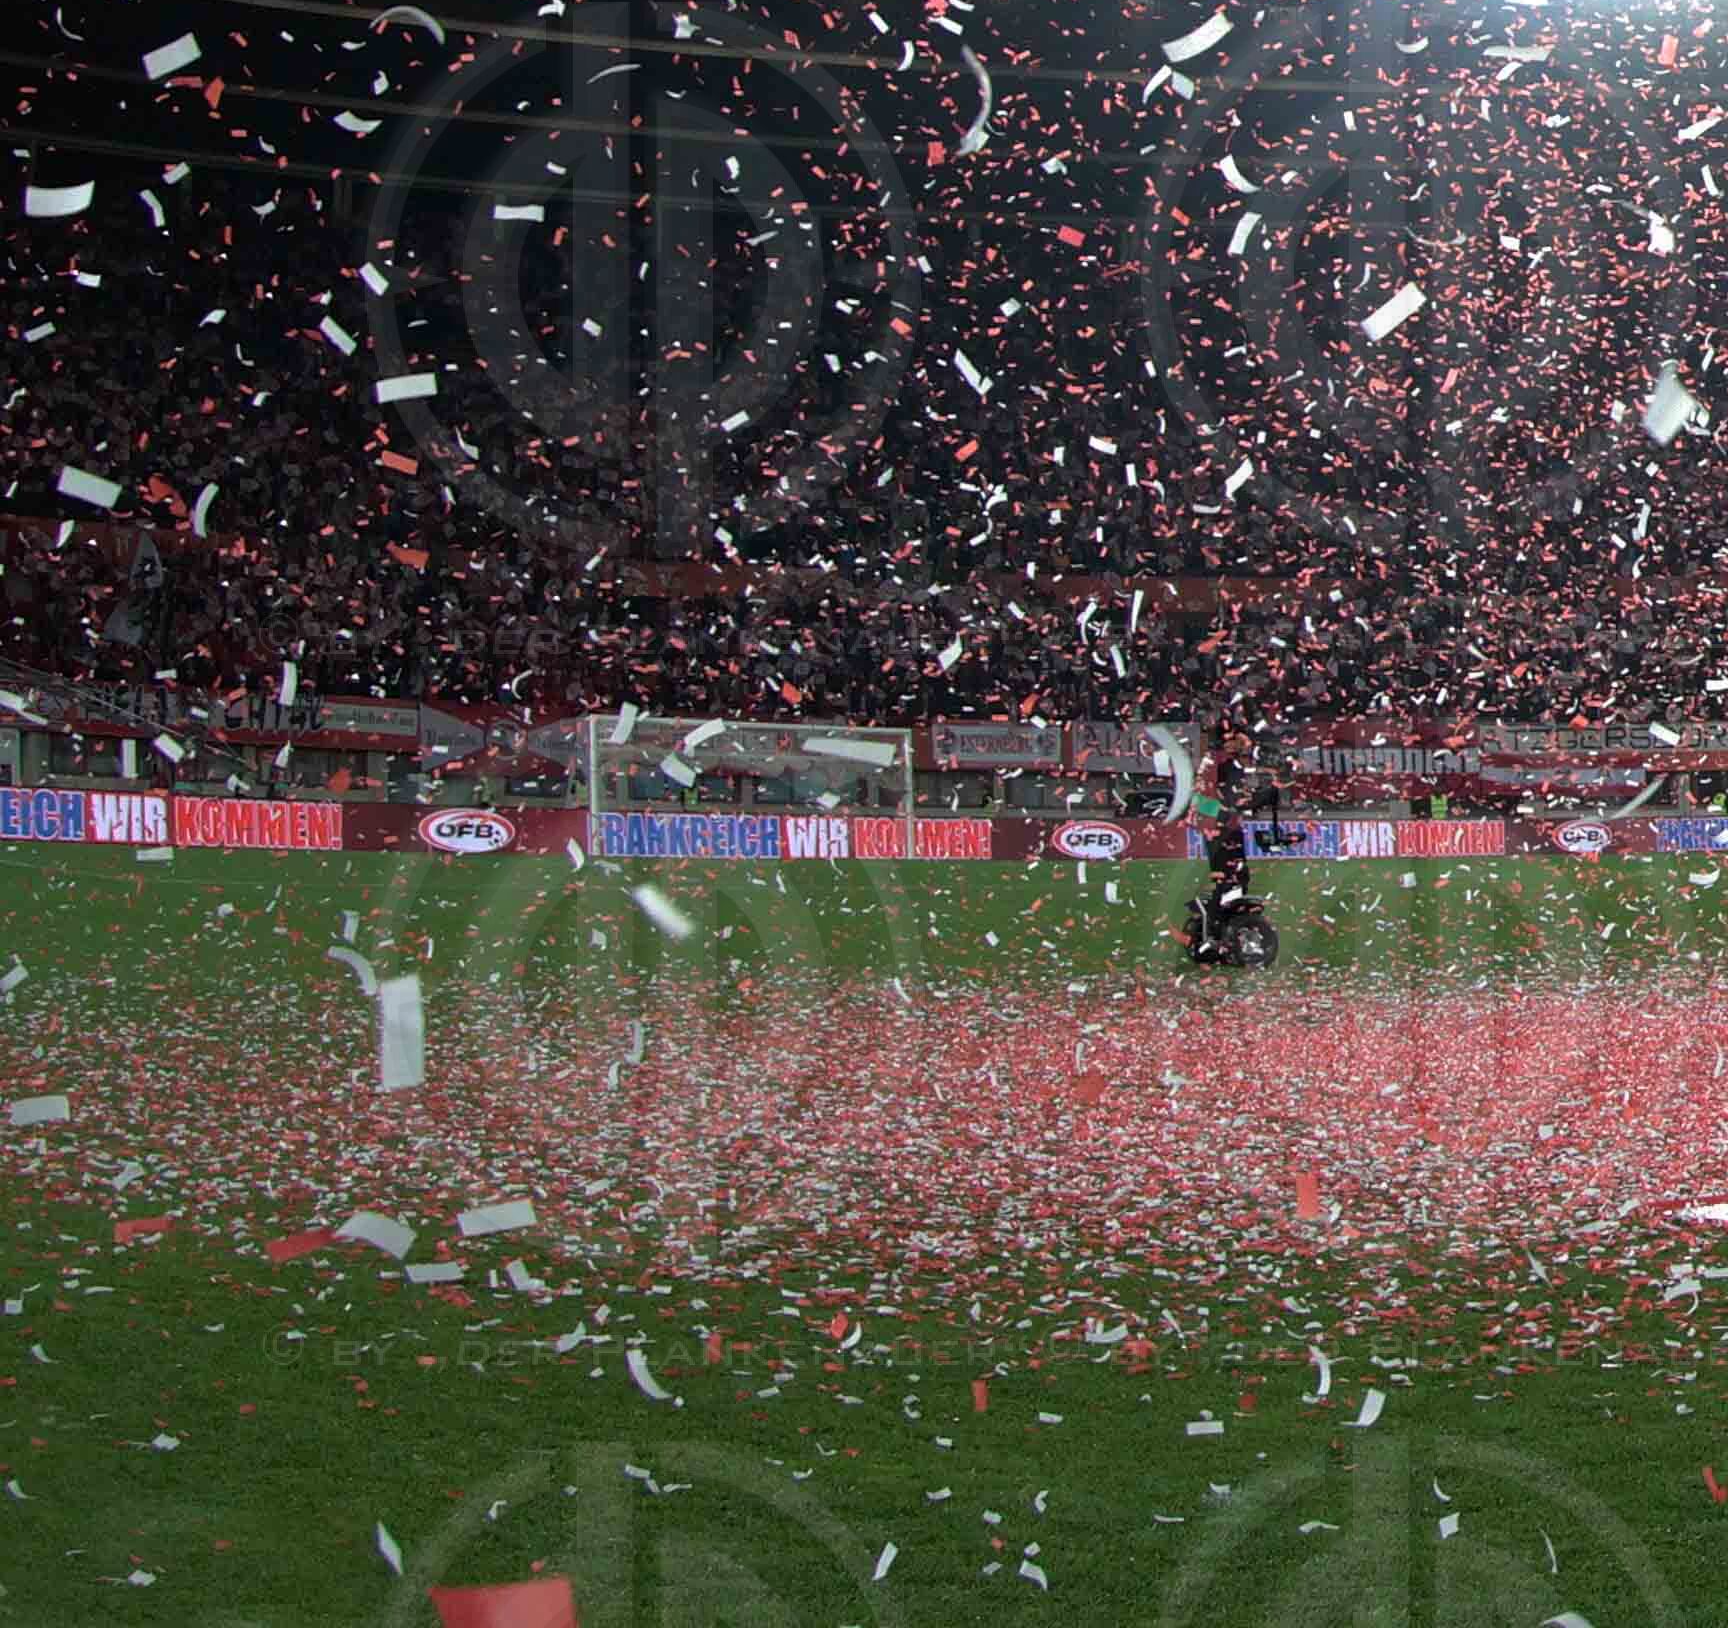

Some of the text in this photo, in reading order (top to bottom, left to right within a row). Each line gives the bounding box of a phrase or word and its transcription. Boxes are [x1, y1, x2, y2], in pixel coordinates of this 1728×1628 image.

[89, 792, 168, 843] WIR
[175, 796, 342, 850] KOMMEN!
[786, 816, 848, 859] WIR
